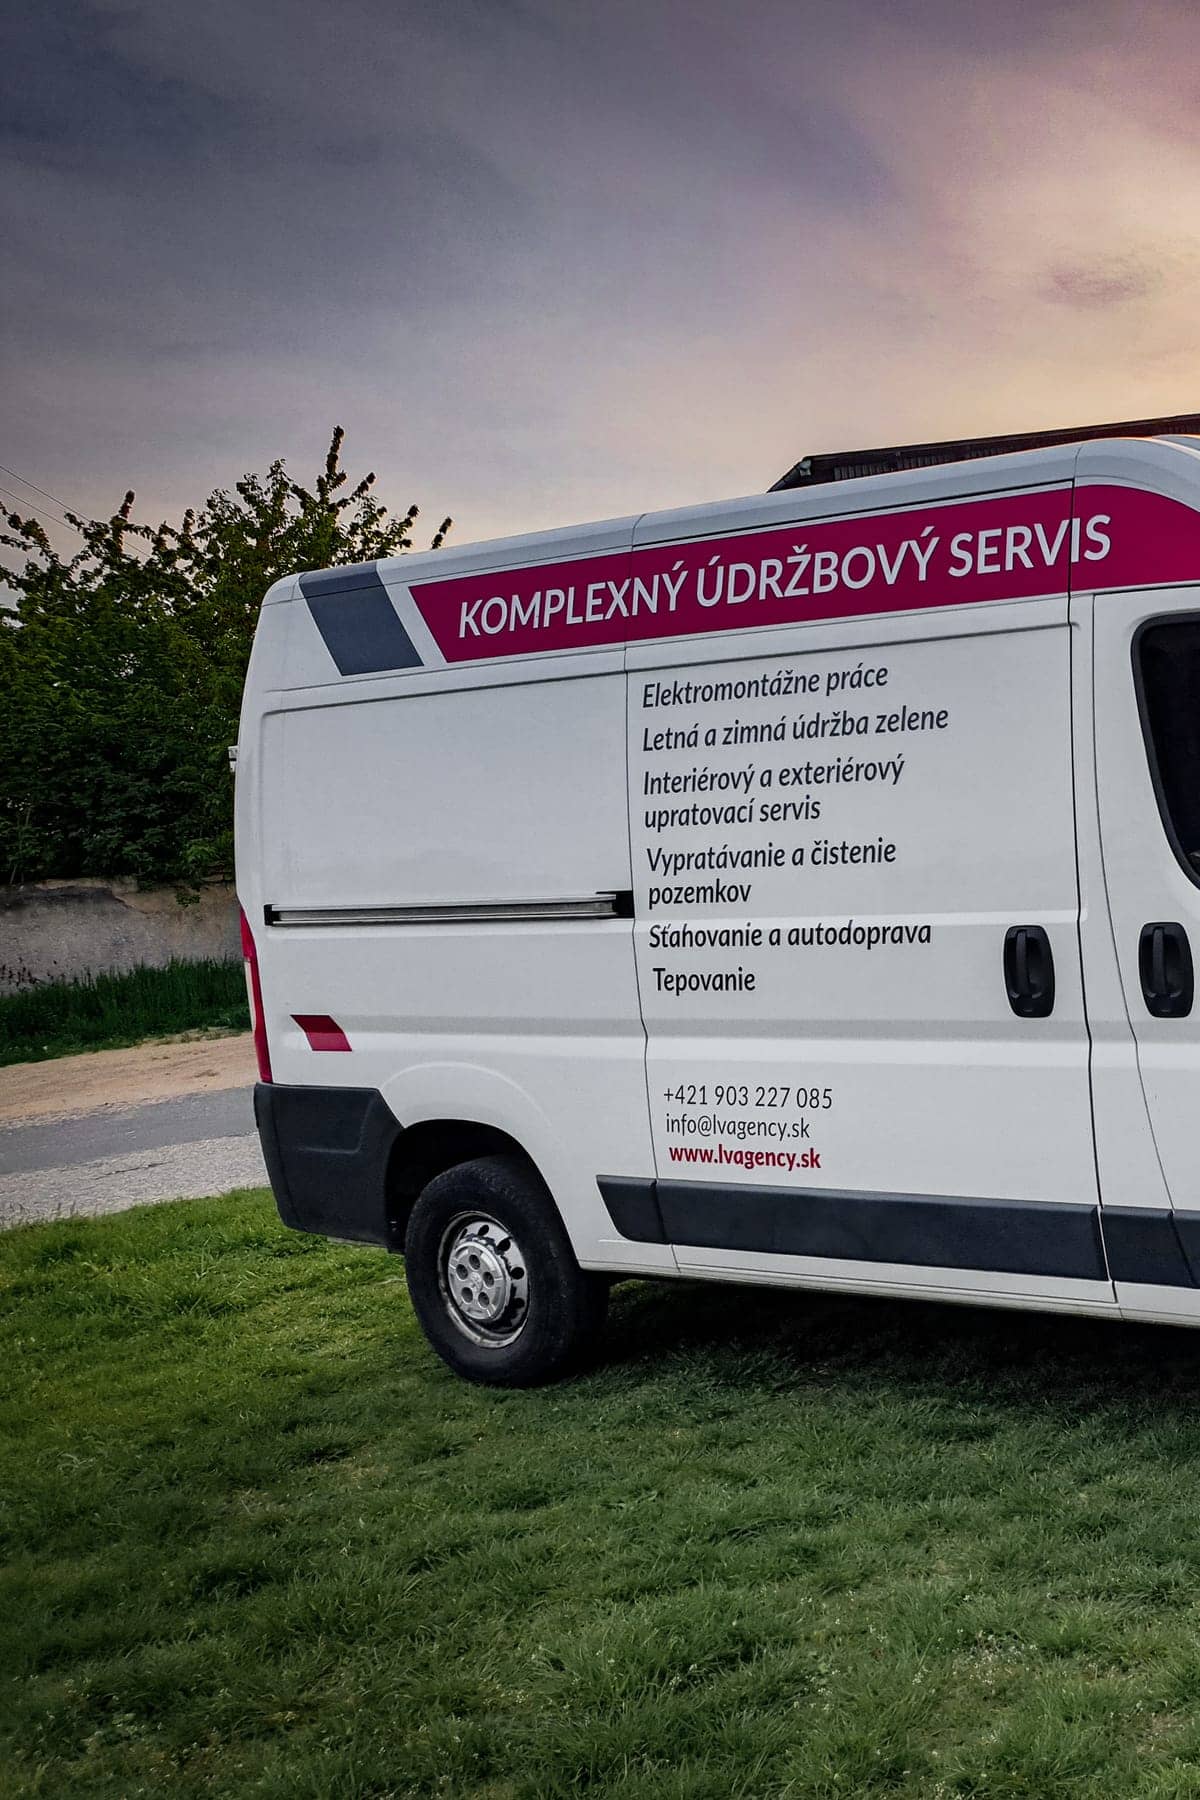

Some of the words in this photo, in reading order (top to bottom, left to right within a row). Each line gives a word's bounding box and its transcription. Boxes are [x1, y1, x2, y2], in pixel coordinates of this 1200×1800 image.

[457, 561, 690, 638] KOMPLEXNÝ
[696, 524, 941, 608] ÚDRŽBOVÝ
[947, 513, 1113, 578] SERVIS
[642, 669, 820, 708] Elektromontážne
[825, 662, 889, 697] práce
[642, 723, 698, 752] Letná
[704, 730, 717, 746] a
[721, 715, 786, 745] zimná
[792, 710, 869, 739] údržba
[875, 705, 949, 733] zelene
[643, 763, 755, 795] Interiérový
[759, 769, 773, 787] a
[778, 753, 905, 787] exteriérový
[644, 798, 756, 833] upratovací
[759, 795, 821, 822] servis
[646, 842, 786, 876] Vypratávanie
[791, 847, 804, 866] a
[810, 837, 897, 866] čistenie
[649, 878, 752, 910] pozemkov
[649, 922, 763, 948] Sťahovanie
[768, 927, 782, 945] a
[787, 919, 932, 950] autodoprava
[652, 966, 756, 996] Tepovanie
[663, 1085, 708, 1105] +421
[714, 1085, 749, 1107] 903
[755, 1087, 791, 1108] 227
[796, 1088, 833, 1109] 085
[665, 1113, 811, 1141] info@lvagency.sk
[669, 1144, 822, 1171] www.lvagency.sk
